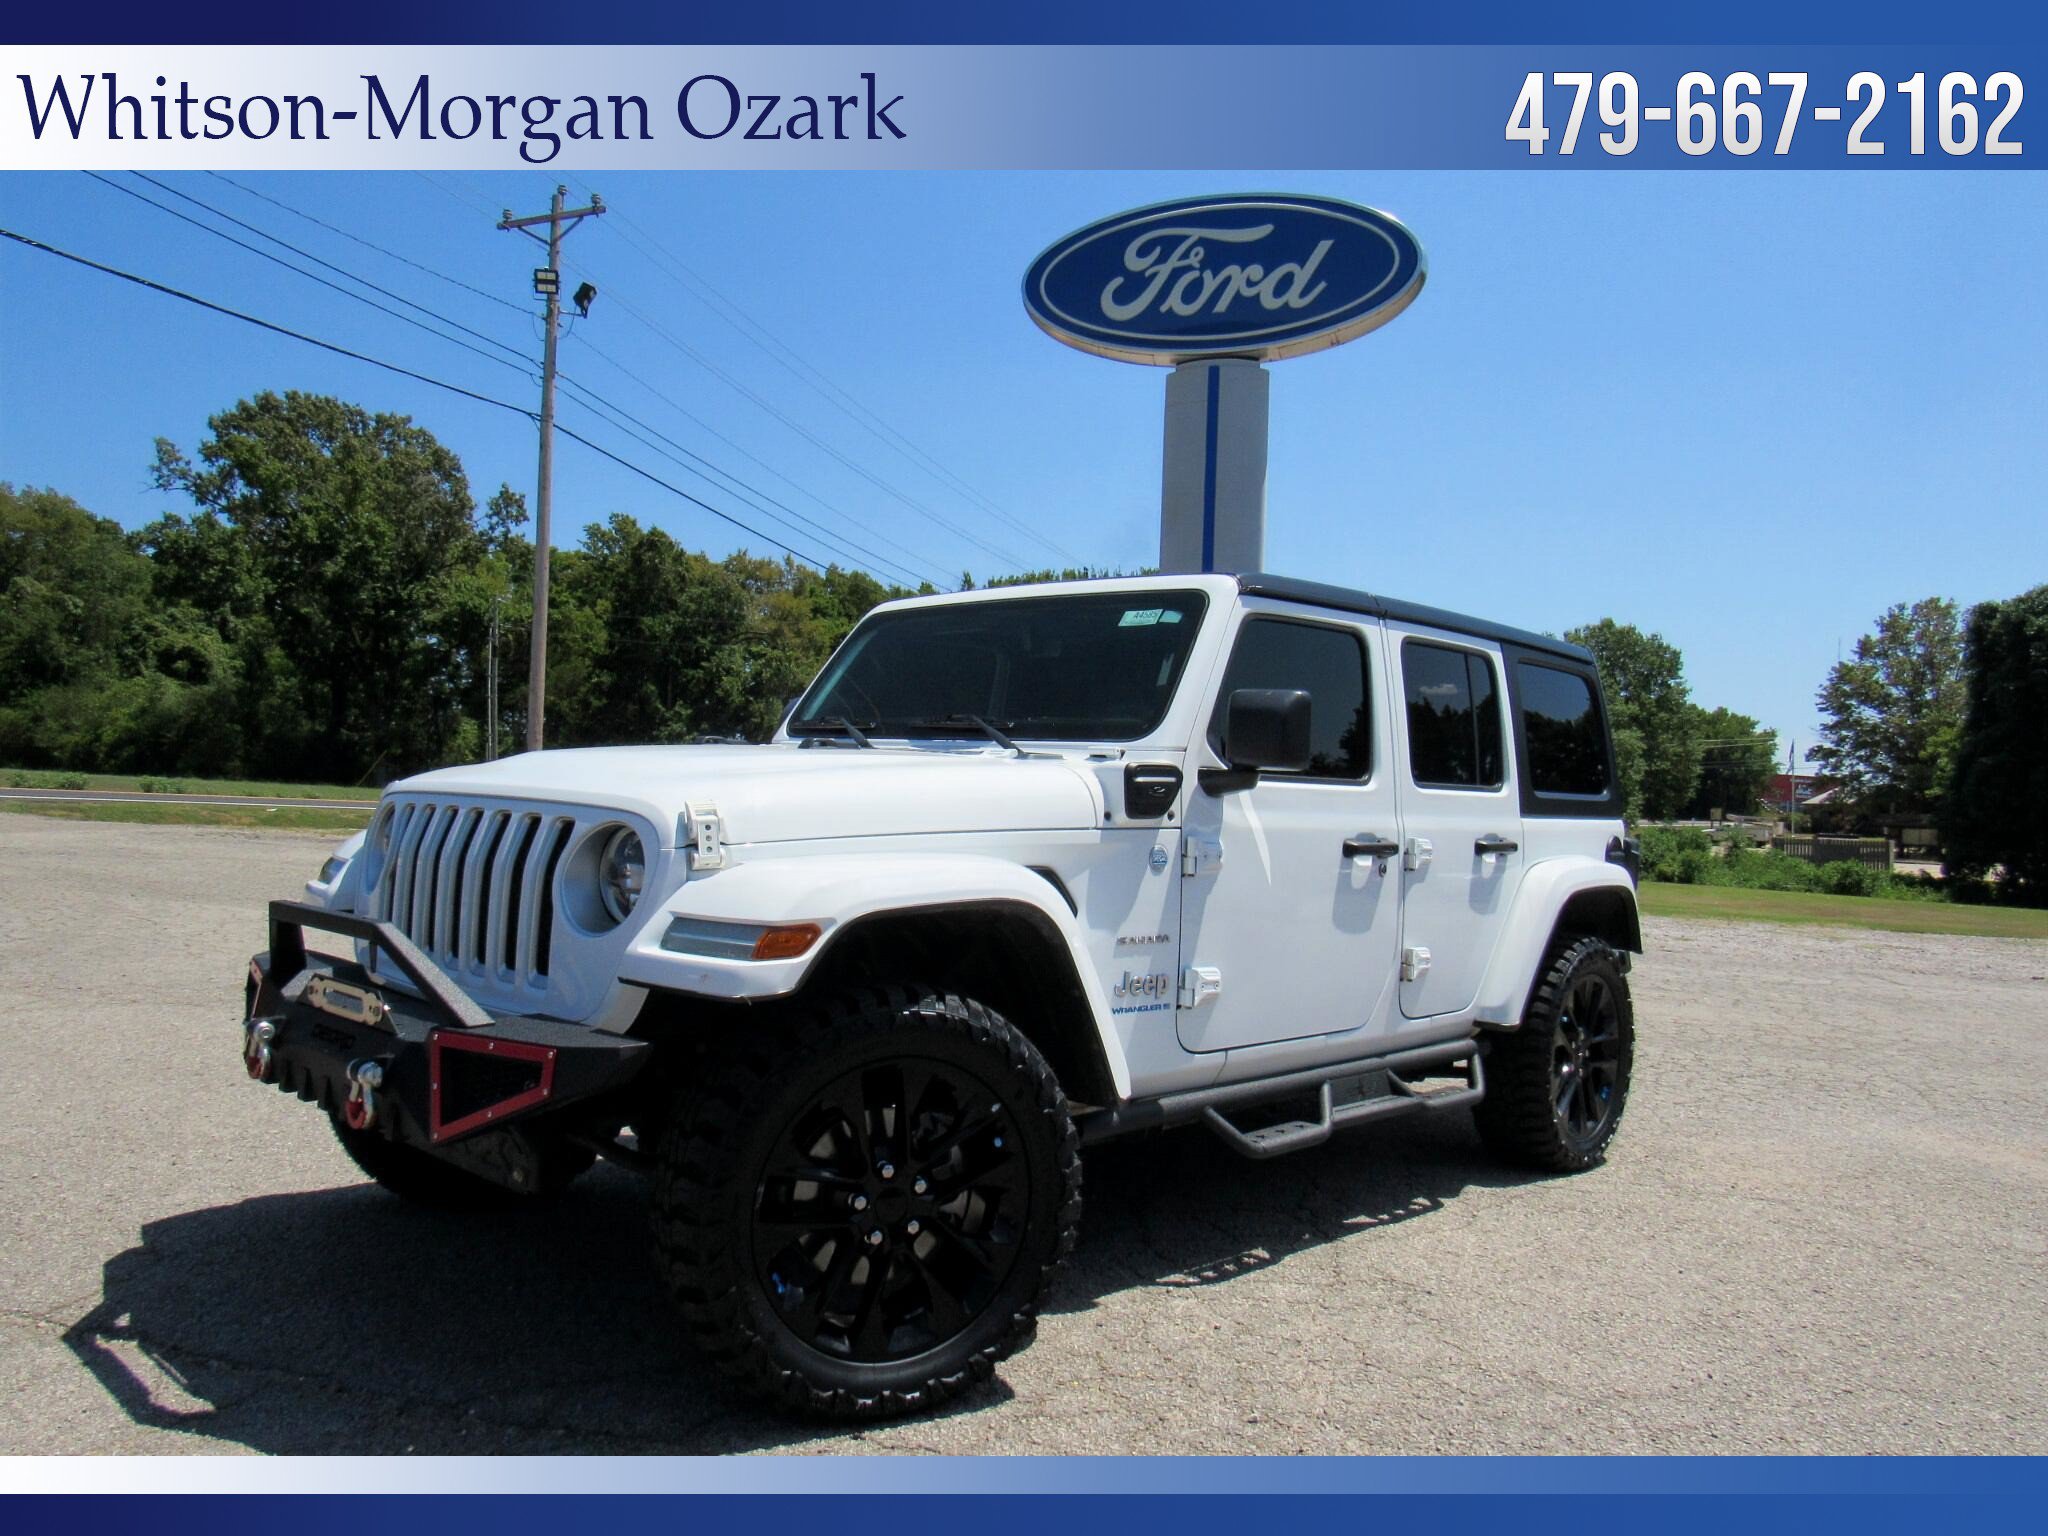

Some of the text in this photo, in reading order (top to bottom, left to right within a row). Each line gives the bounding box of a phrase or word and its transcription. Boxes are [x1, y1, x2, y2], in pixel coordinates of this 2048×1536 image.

[1100, 224, 1334, 322] Ford
[1114, 970, 1169, 1000] Jeep
[1112, 1003, 1162, 1015] WRANGLER
